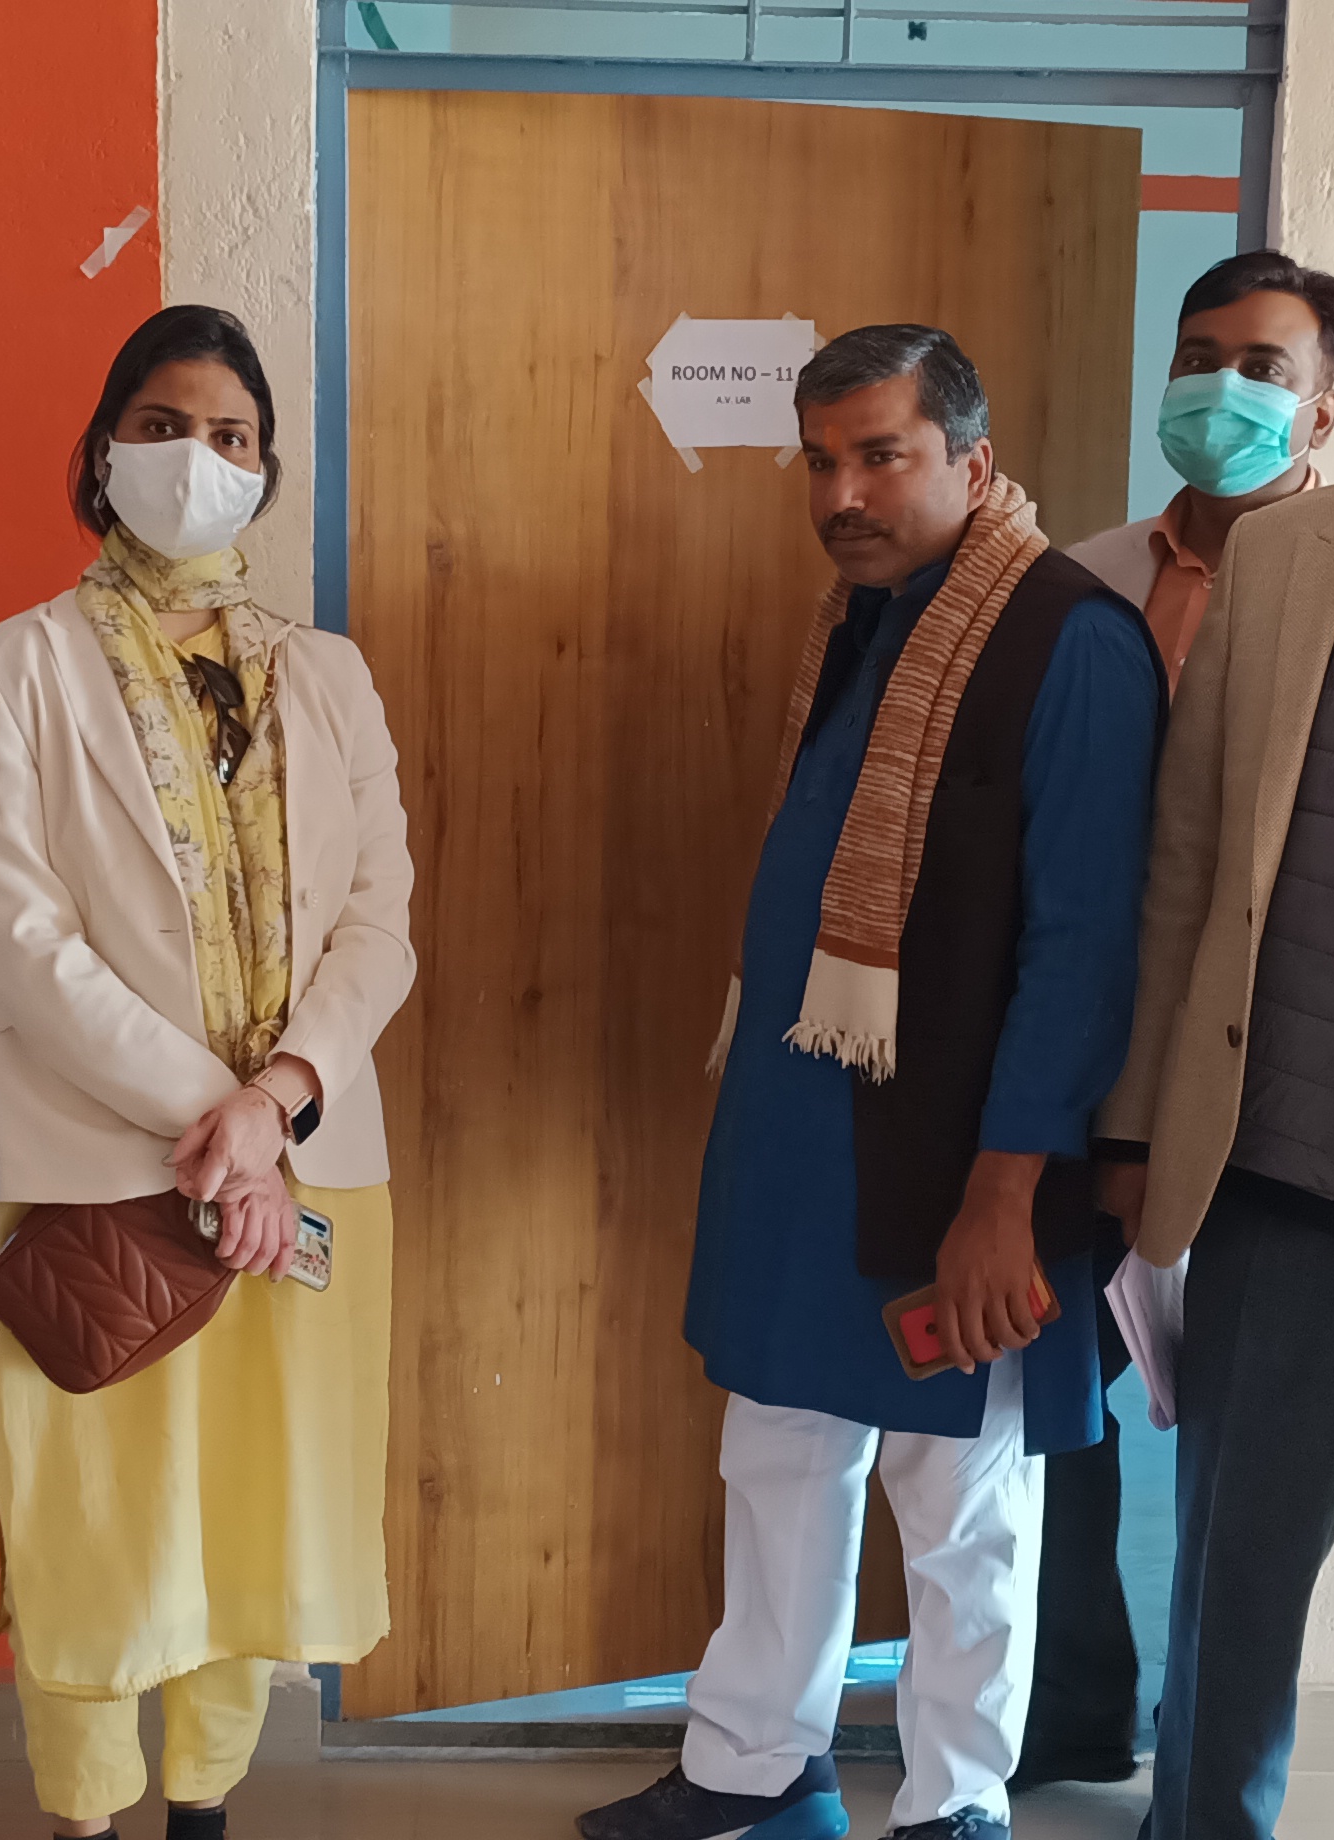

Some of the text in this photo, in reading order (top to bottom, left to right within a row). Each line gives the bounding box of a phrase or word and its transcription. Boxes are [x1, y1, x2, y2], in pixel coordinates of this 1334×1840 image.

[671, 365, 726, 381] ROOM
[731, 365, 757, 381] NO
[776, 366, 794, 382] 11
[735, 396, 752, 405] LAB
